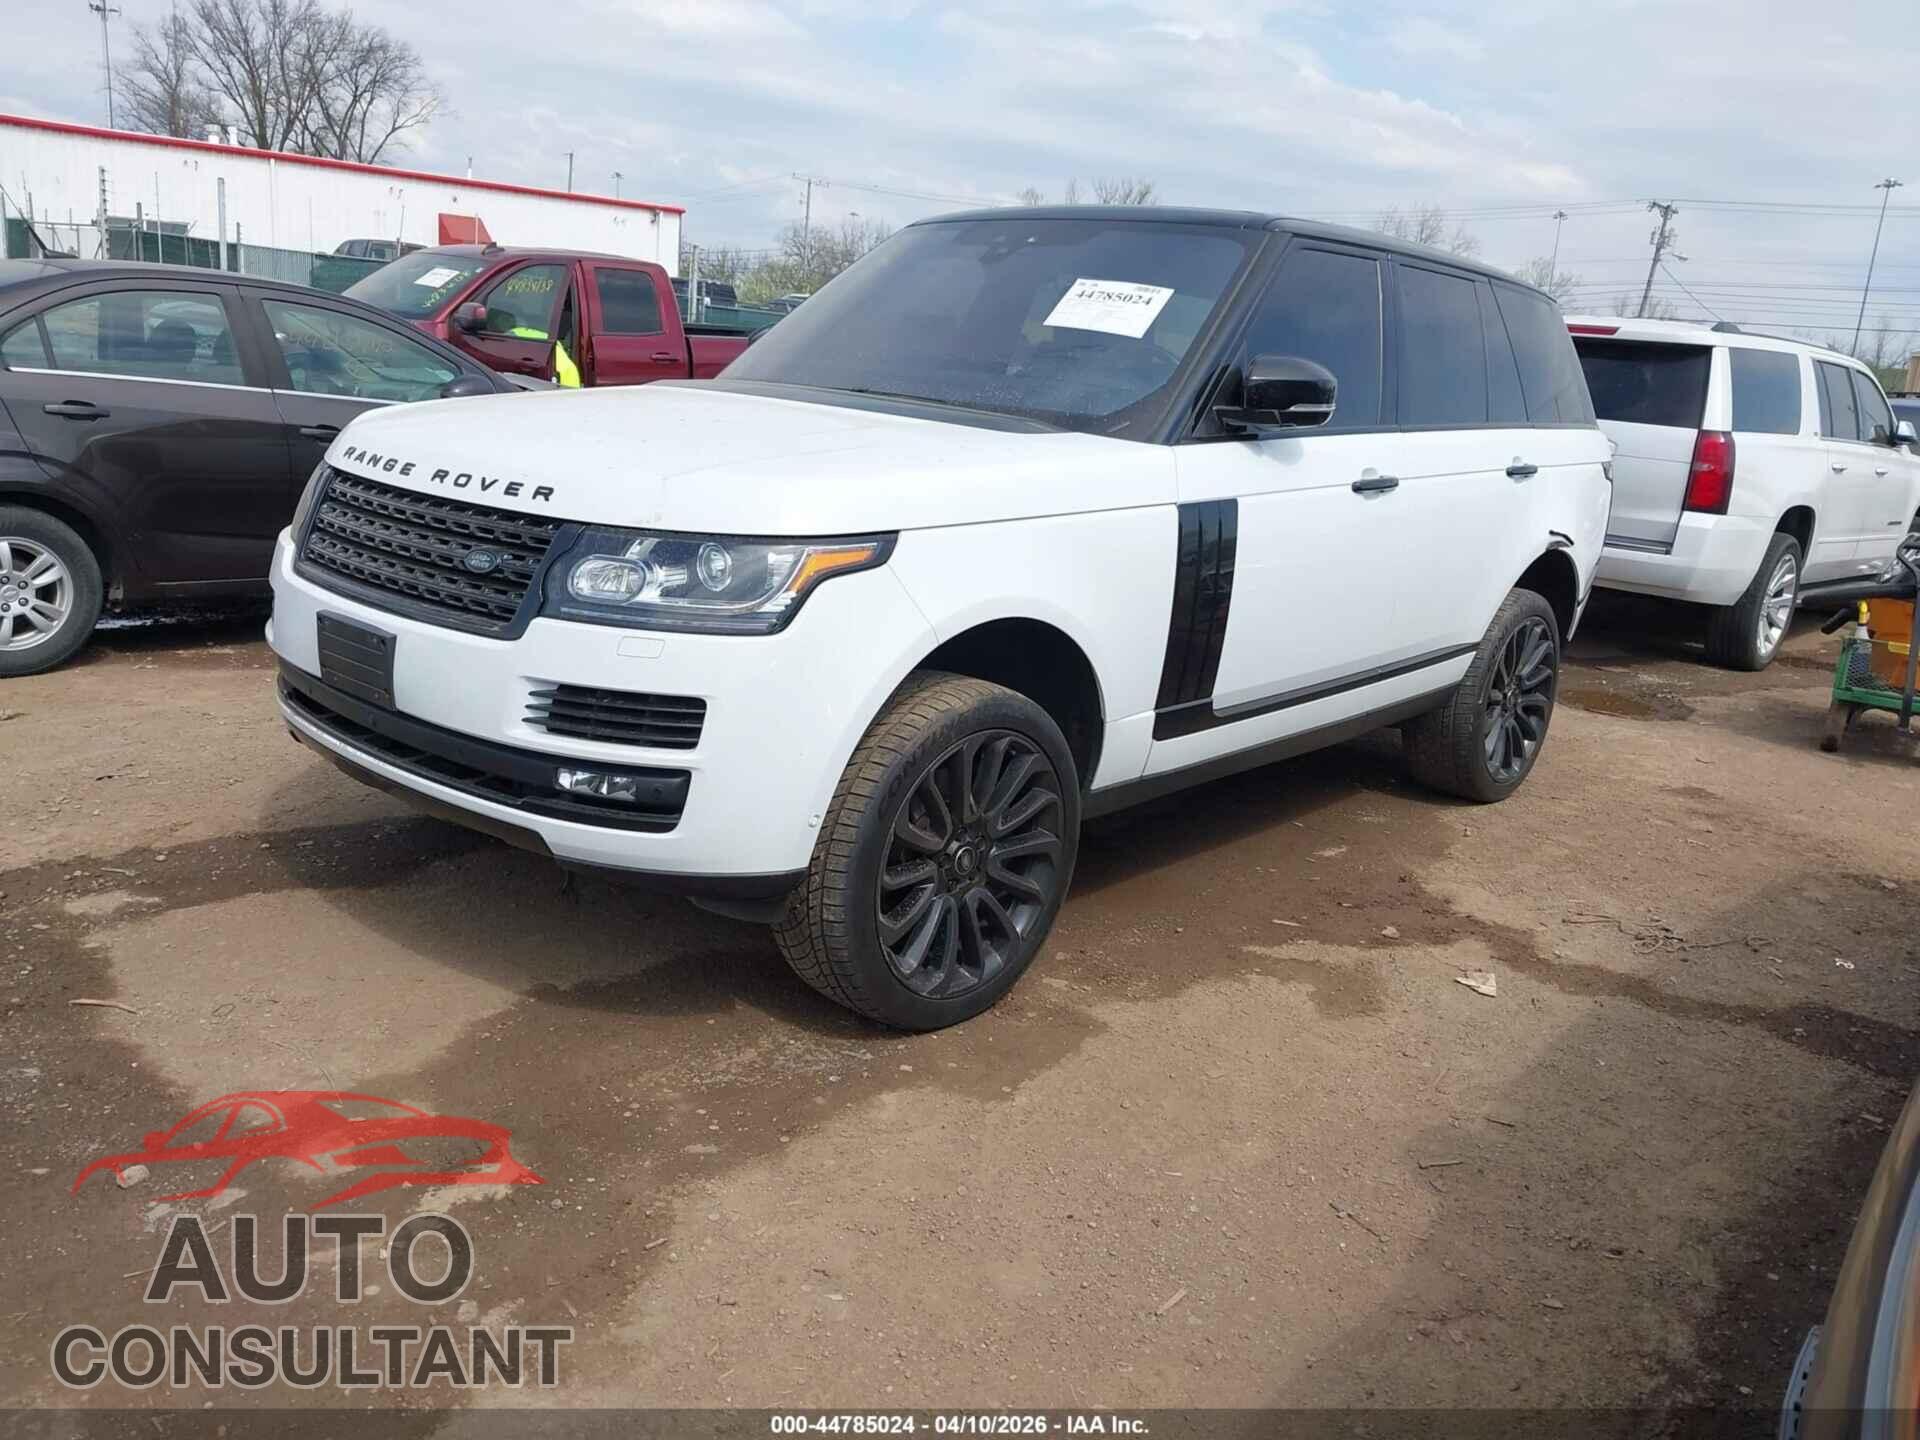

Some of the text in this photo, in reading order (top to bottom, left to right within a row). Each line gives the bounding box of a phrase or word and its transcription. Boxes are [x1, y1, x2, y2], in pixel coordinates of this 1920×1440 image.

[1075, 288, 1153, 306] 44785024
[343, 446, 555, 501] RANGE ROVER
